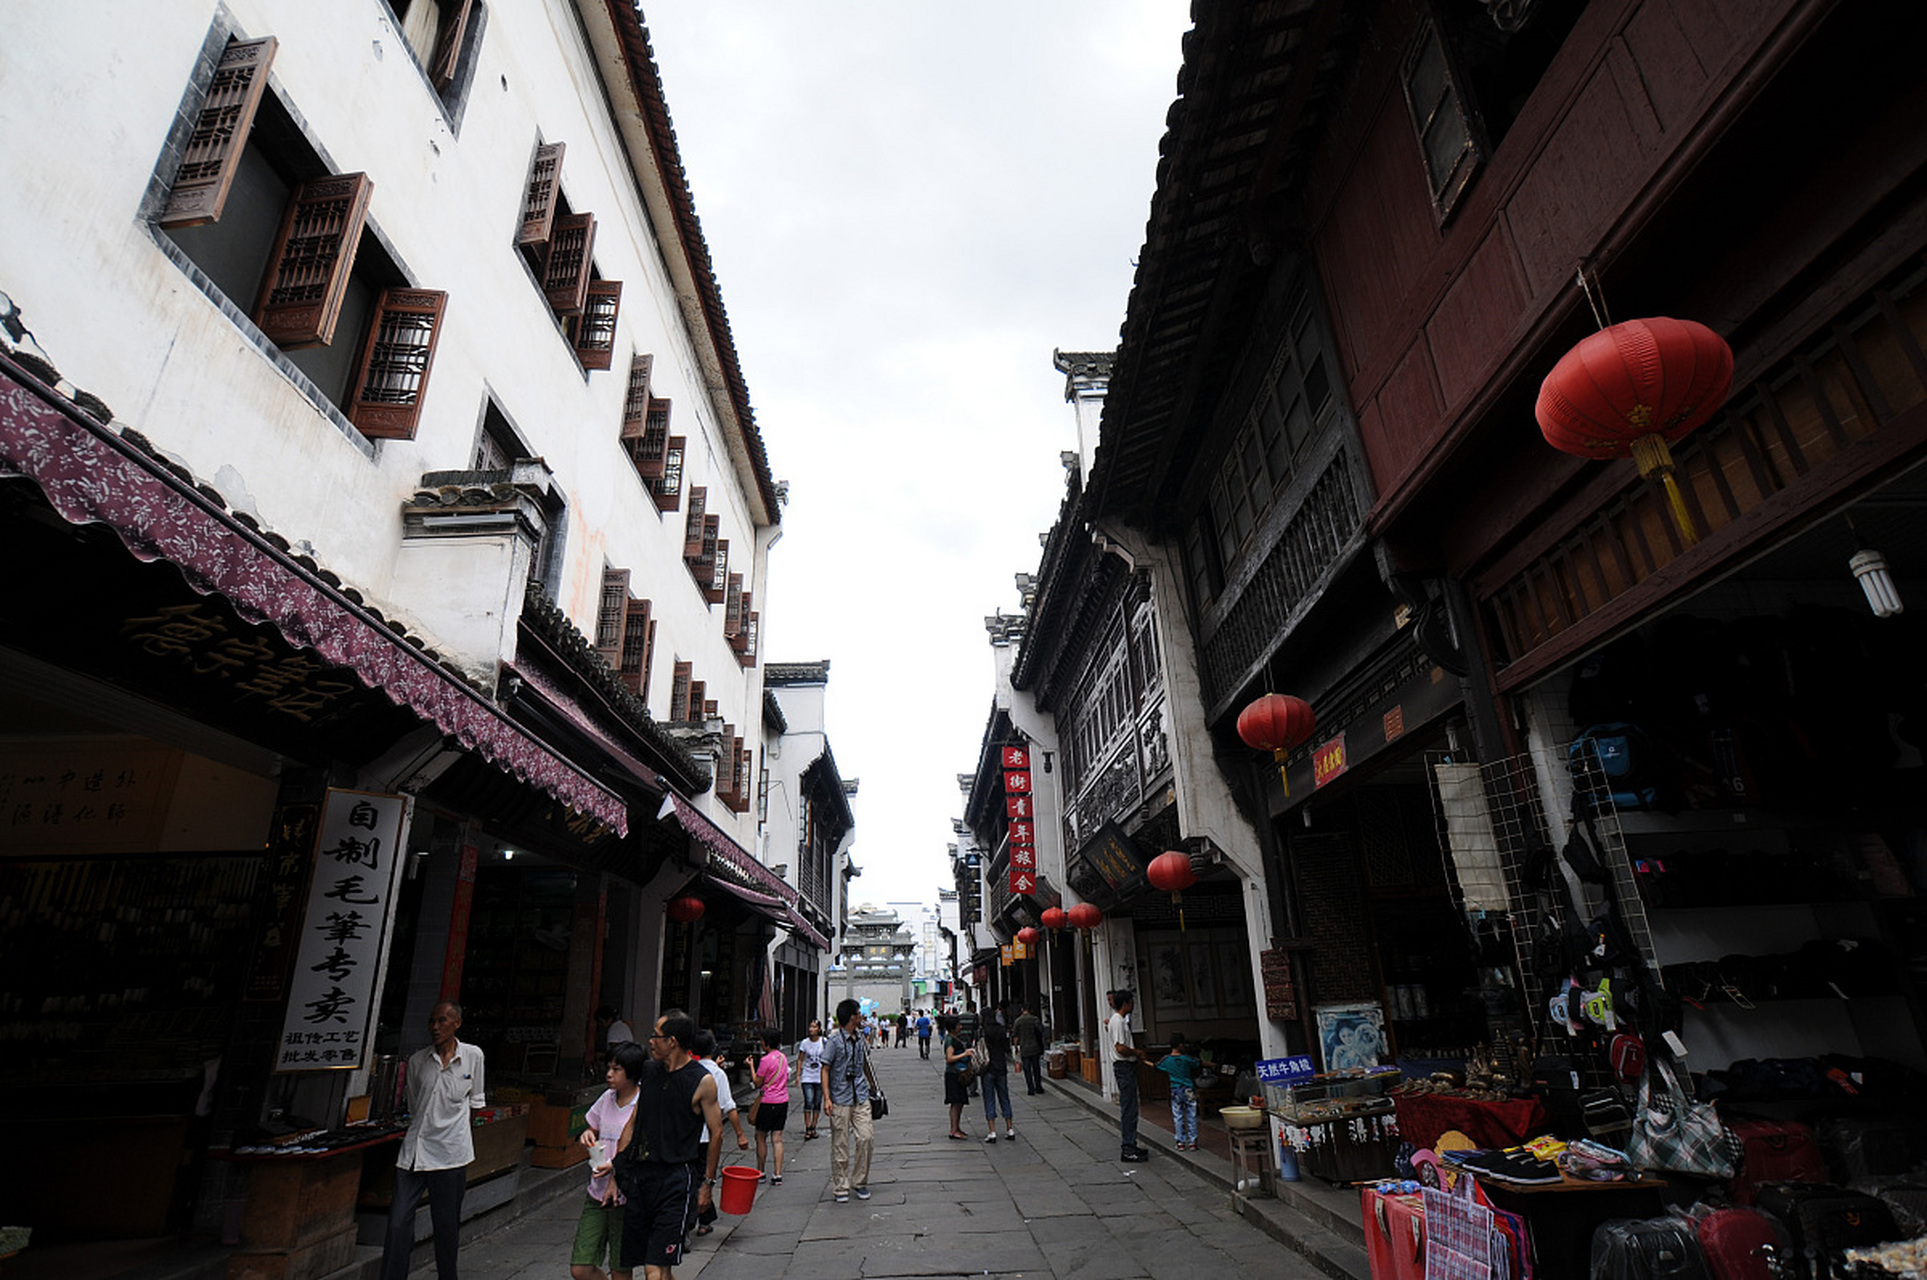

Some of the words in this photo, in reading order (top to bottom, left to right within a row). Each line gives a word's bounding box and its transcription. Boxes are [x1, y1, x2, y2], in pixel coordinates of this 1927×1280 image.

[1008, 750, 1033, 890] 老街青年旅舍
[303, 801, 381, 1023] 自制毛筆专卖
[281, 1048, 357, 1063] 批发零售
[285, 1030, 360, 1045] 祖传工艺
